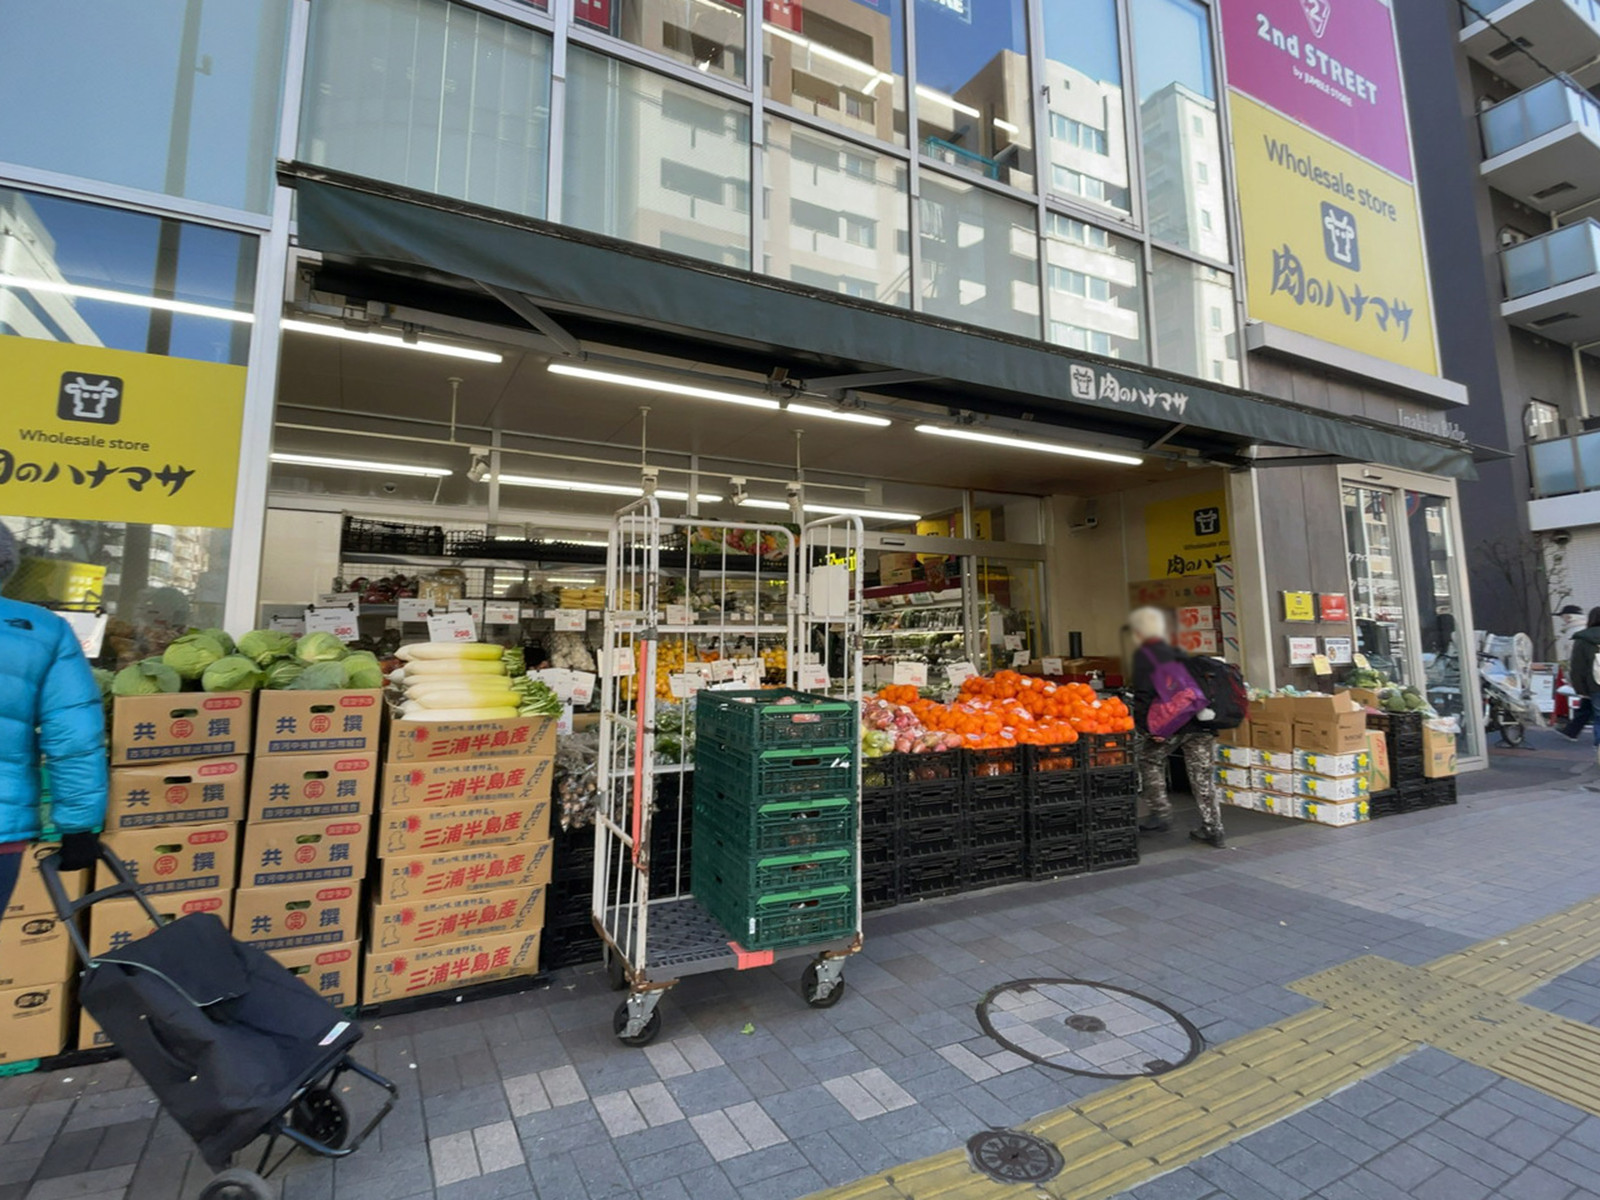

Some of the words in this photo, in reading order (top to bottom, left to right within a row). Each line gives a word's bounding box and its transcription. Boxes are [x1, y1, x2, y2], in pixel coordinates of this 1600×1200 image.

[1256, 13, 1300, 59] 2nd
[1304, 43, 1378, 105] STREET
[1263, 134, 1355, 201] Wholesale
[1358, 187, 1397, 221] store
[1270, 243, 1414, 342] 肉のハナマサ
[1099, 372, 1189, 415] 肉のハナマサ
[19, 428, 105, 448] Wholesale
[109, 438, 150, 451] store
[0, 448, 196, 497] のハナマサ
[133, 722, 156, 740] 共
[276, 716, 296, 734] 共
[427, 725, 530, 758] 三浦半島産
[127, 789, 150, 807] 共
[269, 783, 290, 800] 共
[423, 768, 526, 802] 三浦半島産
[420, 811, 523, 848] 三浦半島産
[261, 848, 282, 867] 共
[422, 853, 525, 894] 三浦半島産
[251, 915, 271, 934] 共
[413, 899, 519, 942] 三浦半島産
[406, 946, 512, 992] 三浦半島産
